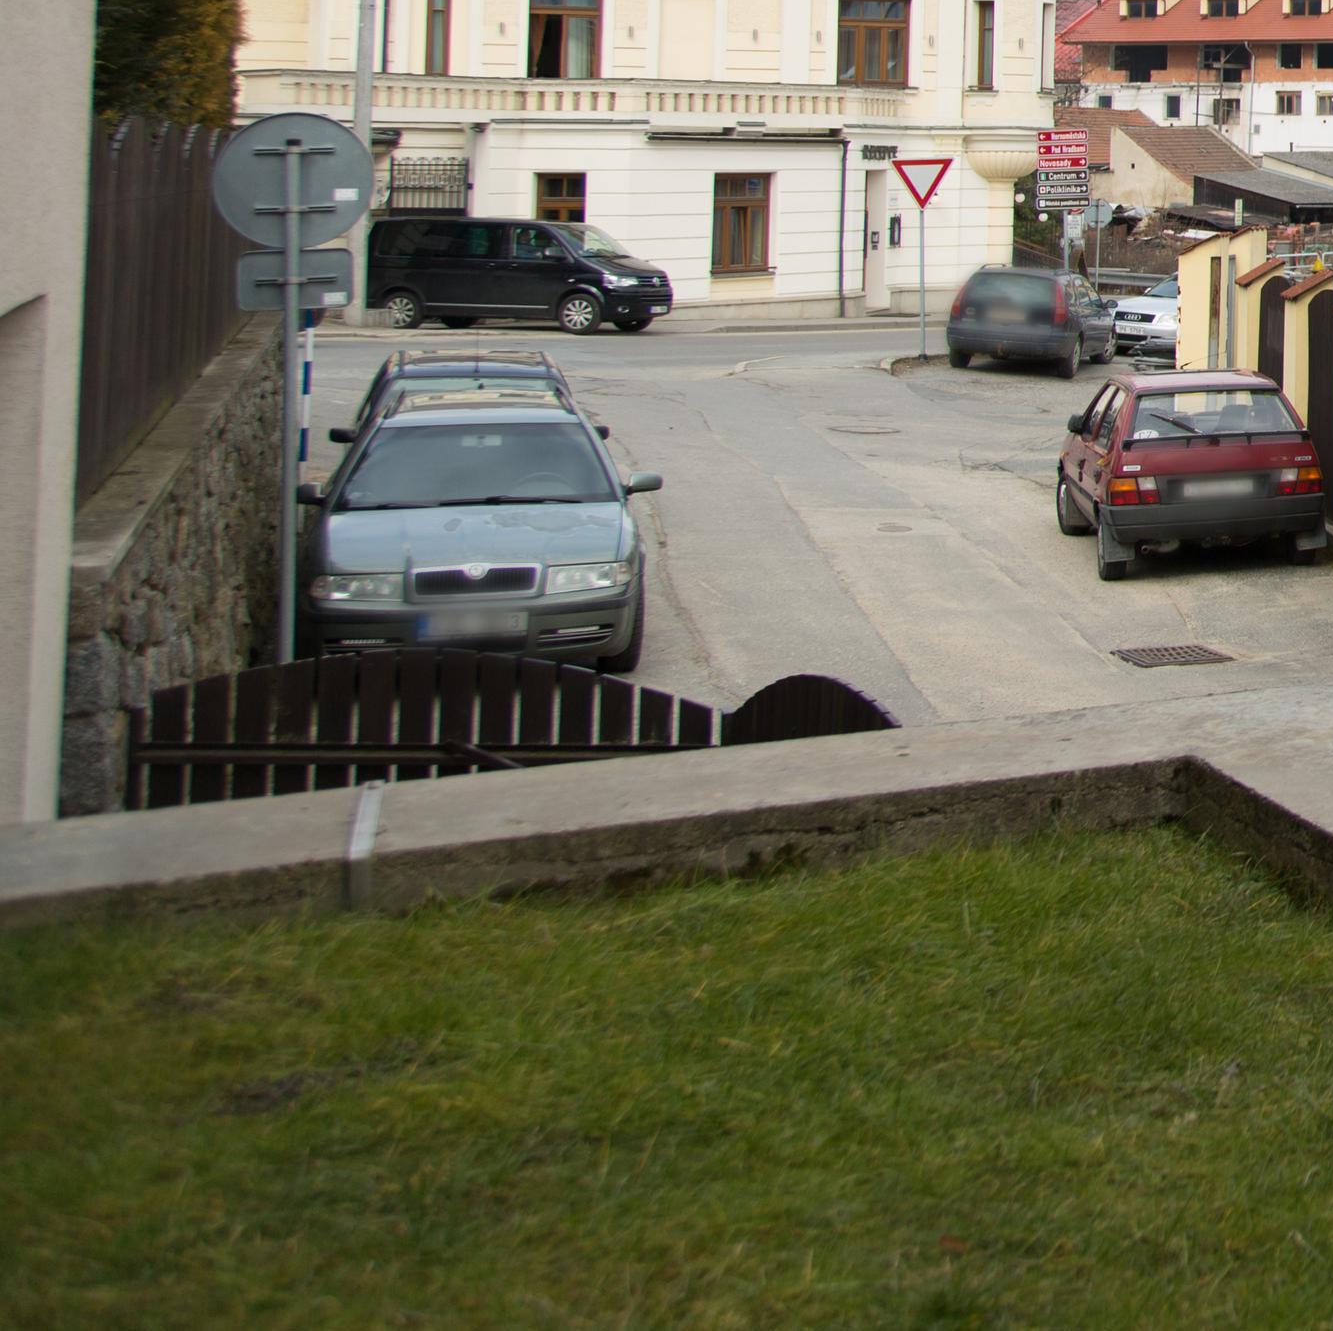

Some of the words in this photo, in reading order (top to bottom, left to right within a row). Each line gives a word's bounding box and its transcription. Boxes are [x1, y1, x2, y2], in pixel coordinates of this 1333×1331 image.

[1051, 145, 1061, 154] Pod
[1039, 159, 1071, 168] Novosady
[1048, 172, 1077, 180] Centrum
[1046, 186, 1081, 194] Poliklinika
